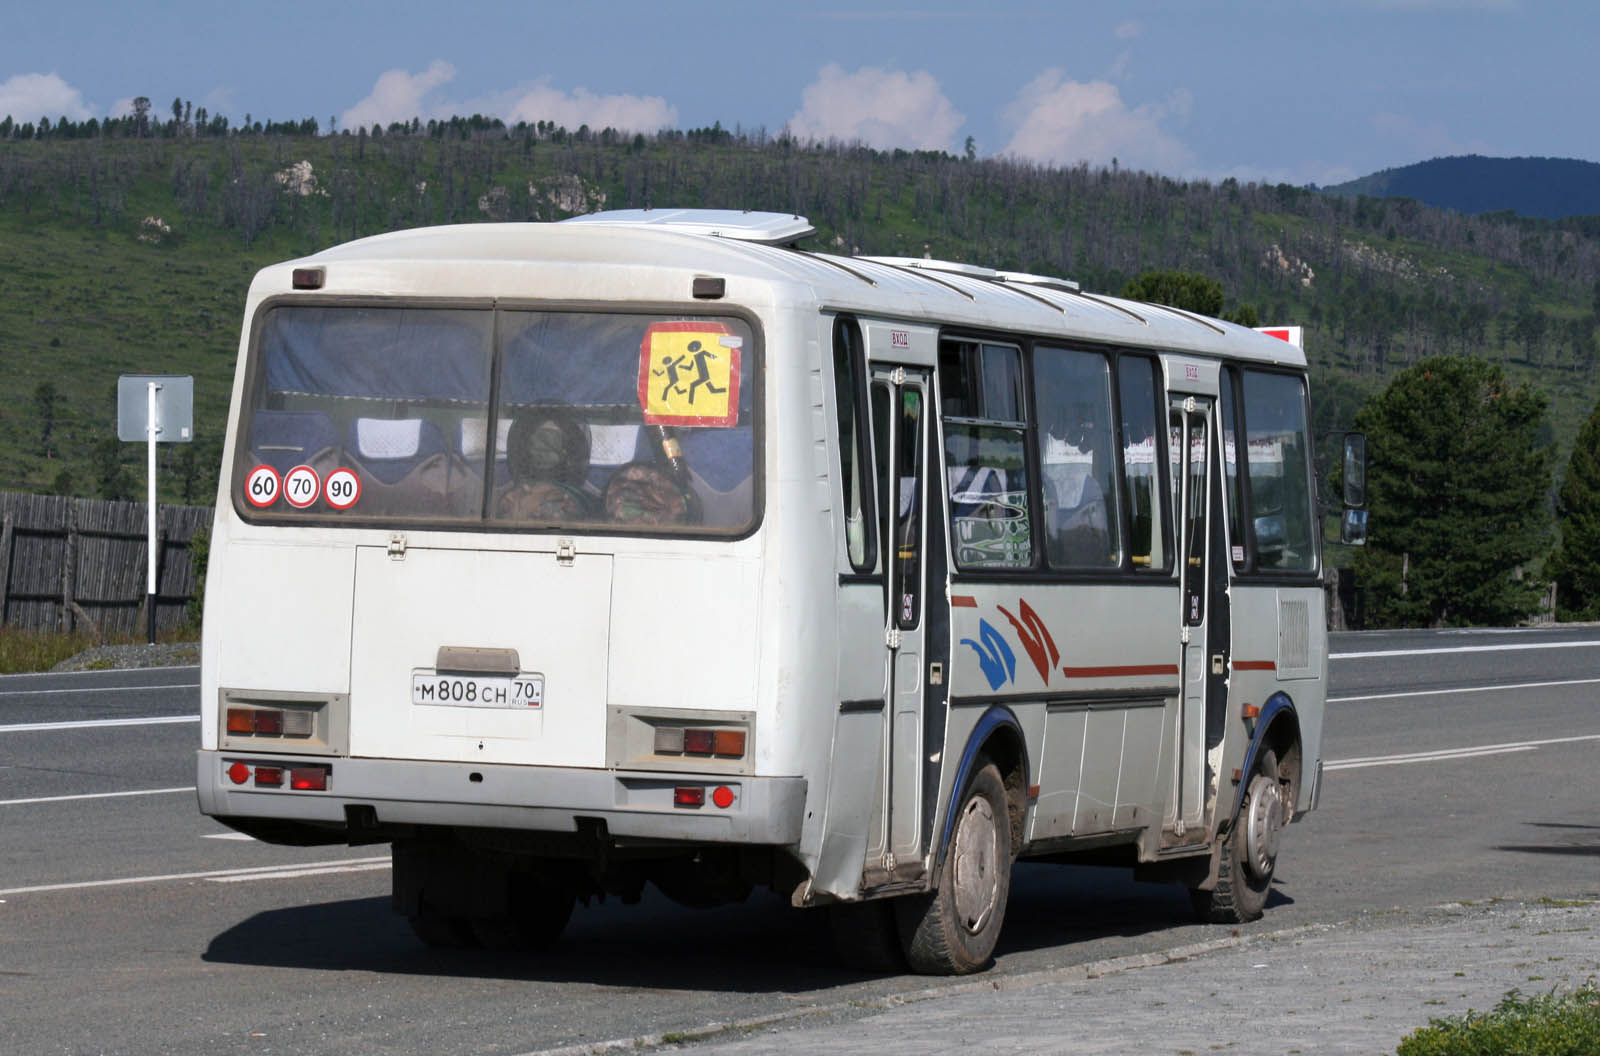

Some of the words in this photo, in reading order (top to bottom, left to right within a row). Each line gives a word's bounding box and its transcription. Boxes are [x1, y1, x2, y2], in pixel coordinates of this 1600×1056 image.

[892, 332, 908, 345] ВХОД
[252, 476, 274, 496] 60
[293, 478, 312, 495] 70
[331, 480, 353, 497] 90
[514, 682, 535, 699] 70
